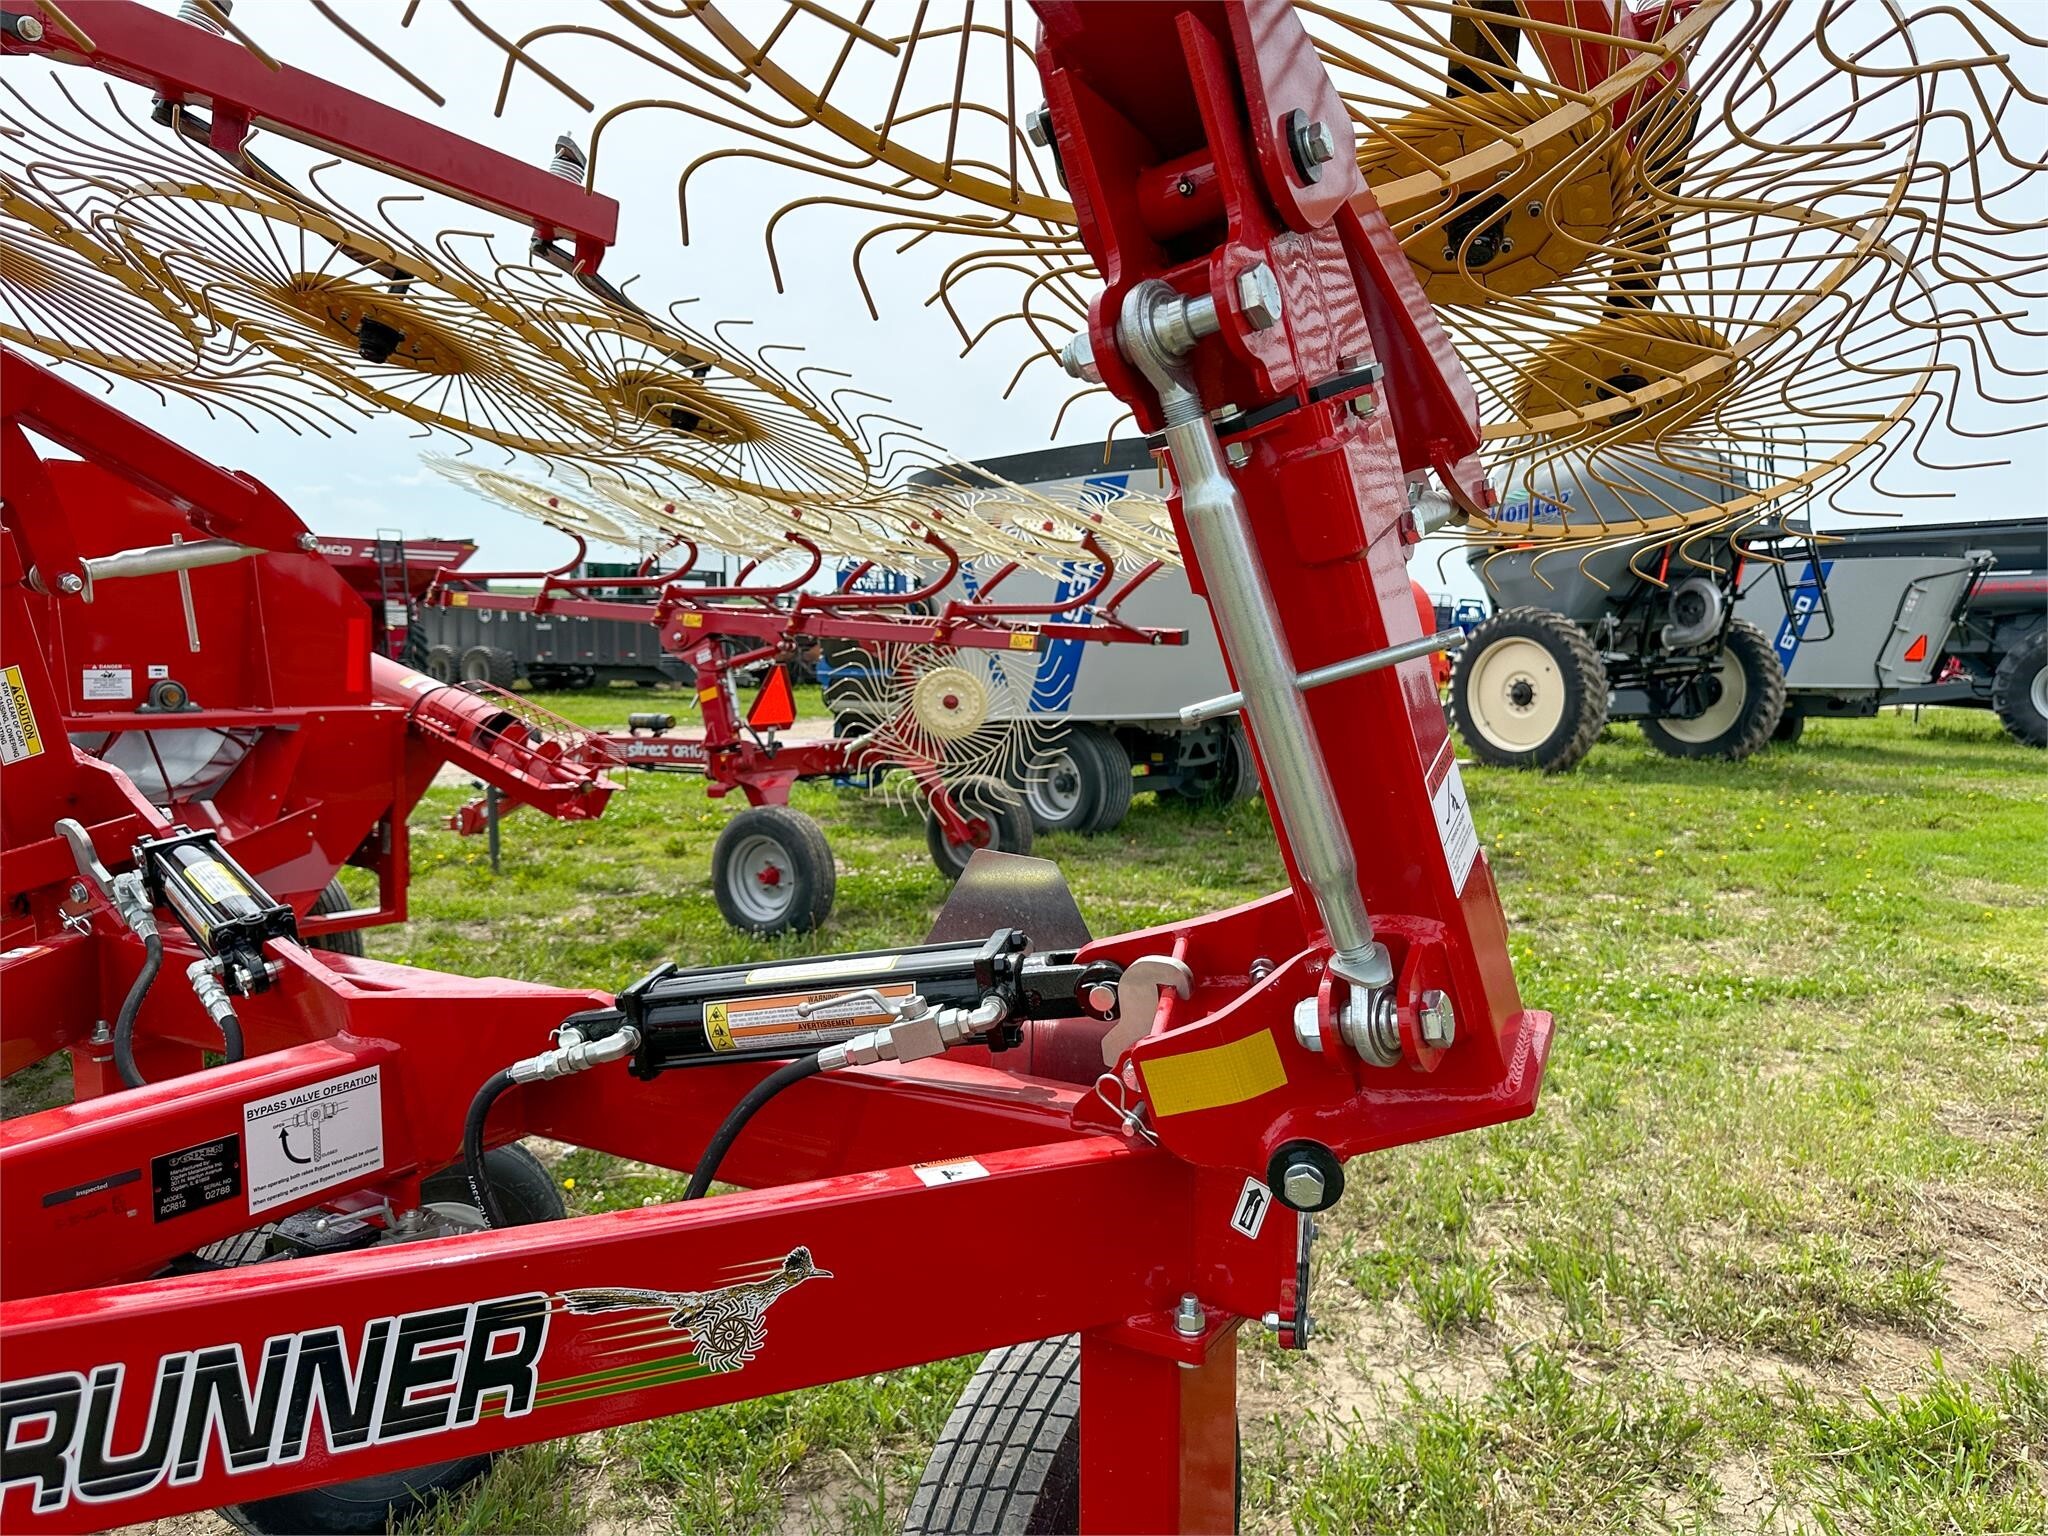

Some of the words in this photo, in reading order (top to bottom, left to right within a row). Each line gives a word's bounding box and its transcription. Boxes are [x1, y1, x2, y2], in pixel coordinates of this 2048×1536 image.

[1, 681, 10, 697] STAY
[6, 699, 17, 720] CLEAR
[15, 695, 36, 739] CAUTION
[13, 720, 20, 729] OF
[5, 724, 20, 758] LOWERING
[16, 730, 26, 747] CART
[798, 1018, 856, 1031] AVERTISSEMENT
[246, 1100, 287, 1119] BYPASS
[289, 1090, 320, 1106] VALVE
[323, 1073, 378, 1096] OPERATION
[75, 1182, 109, 1197] Inspected
[204, 1182, 222, 1191] SERIAL
[205, 1185, 231, 1200] 02788
[163, 1193, 184, 1204] MODEL
[160, 1199, 186, 1215] RCR812
[0, 1290, 553, 1516] RUNNER
